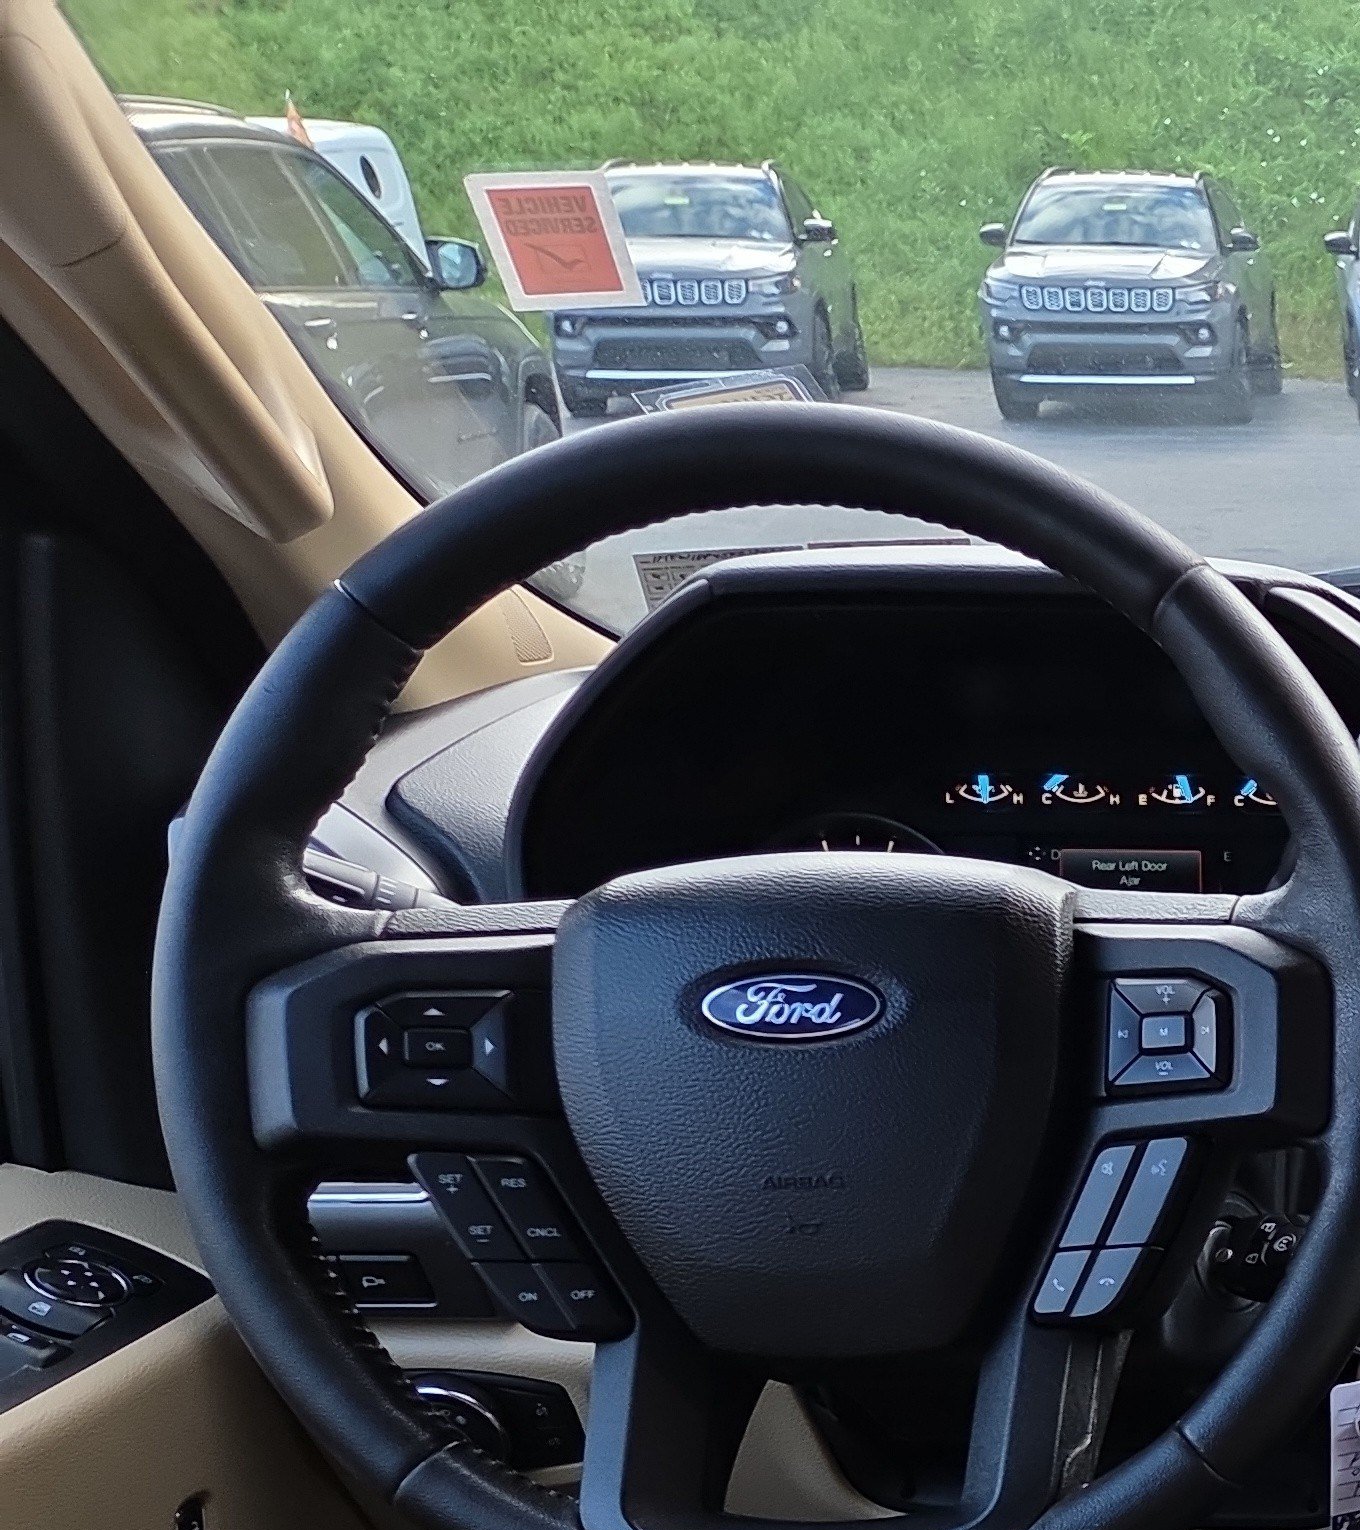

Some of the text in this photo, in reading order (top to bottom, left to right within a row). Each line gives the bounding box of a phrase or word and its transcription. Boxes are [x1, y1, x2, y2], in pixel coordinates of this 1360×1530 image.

[1092, 861, 1167, 871] Rear Left Door
[1120, 876, 1140, 886] Ajar
[1156, 986, 1175, 995] VOL
[736, 982, 844, 1025] Ford
[425, 1042, 445, 1051] OK
[1155, 1061, 1173, 1070] VOL
[438, 1174, 463, 1184] SET
[501, 1178, 526, 1187] RES
[468, 1225, 493, 1235] SET
[527, 1228, 561, 1237] CNCL
[518, 1293, 538, 1301] ON
[570, 1290, 595, 1300] OFF
